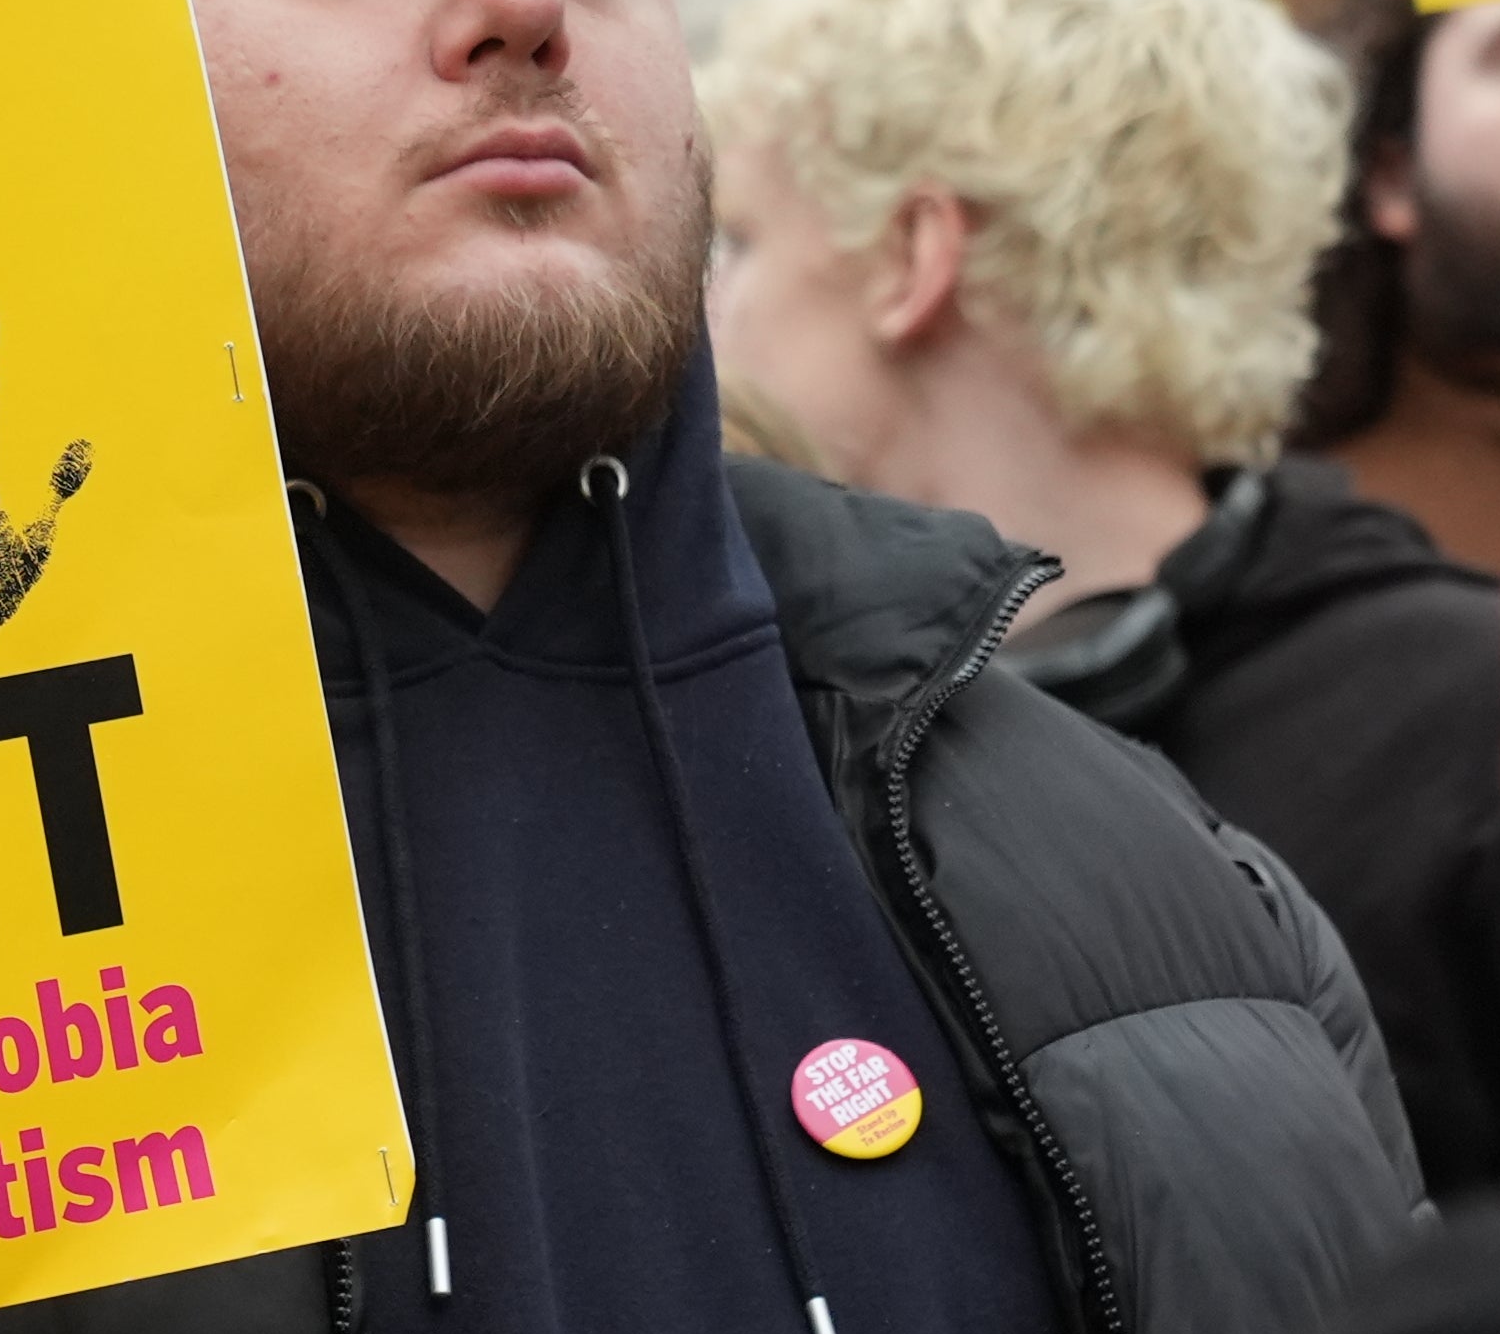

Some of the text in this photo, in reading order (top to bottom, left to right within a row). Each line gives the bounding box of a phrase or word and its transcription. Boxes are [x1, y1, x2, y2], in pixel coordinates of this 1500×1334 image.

[805, 1044, 857, 1084] STOP
[806, 1056, 889, 1111] THE FAR
[830, 1079, 892, 1126] RIGHT
